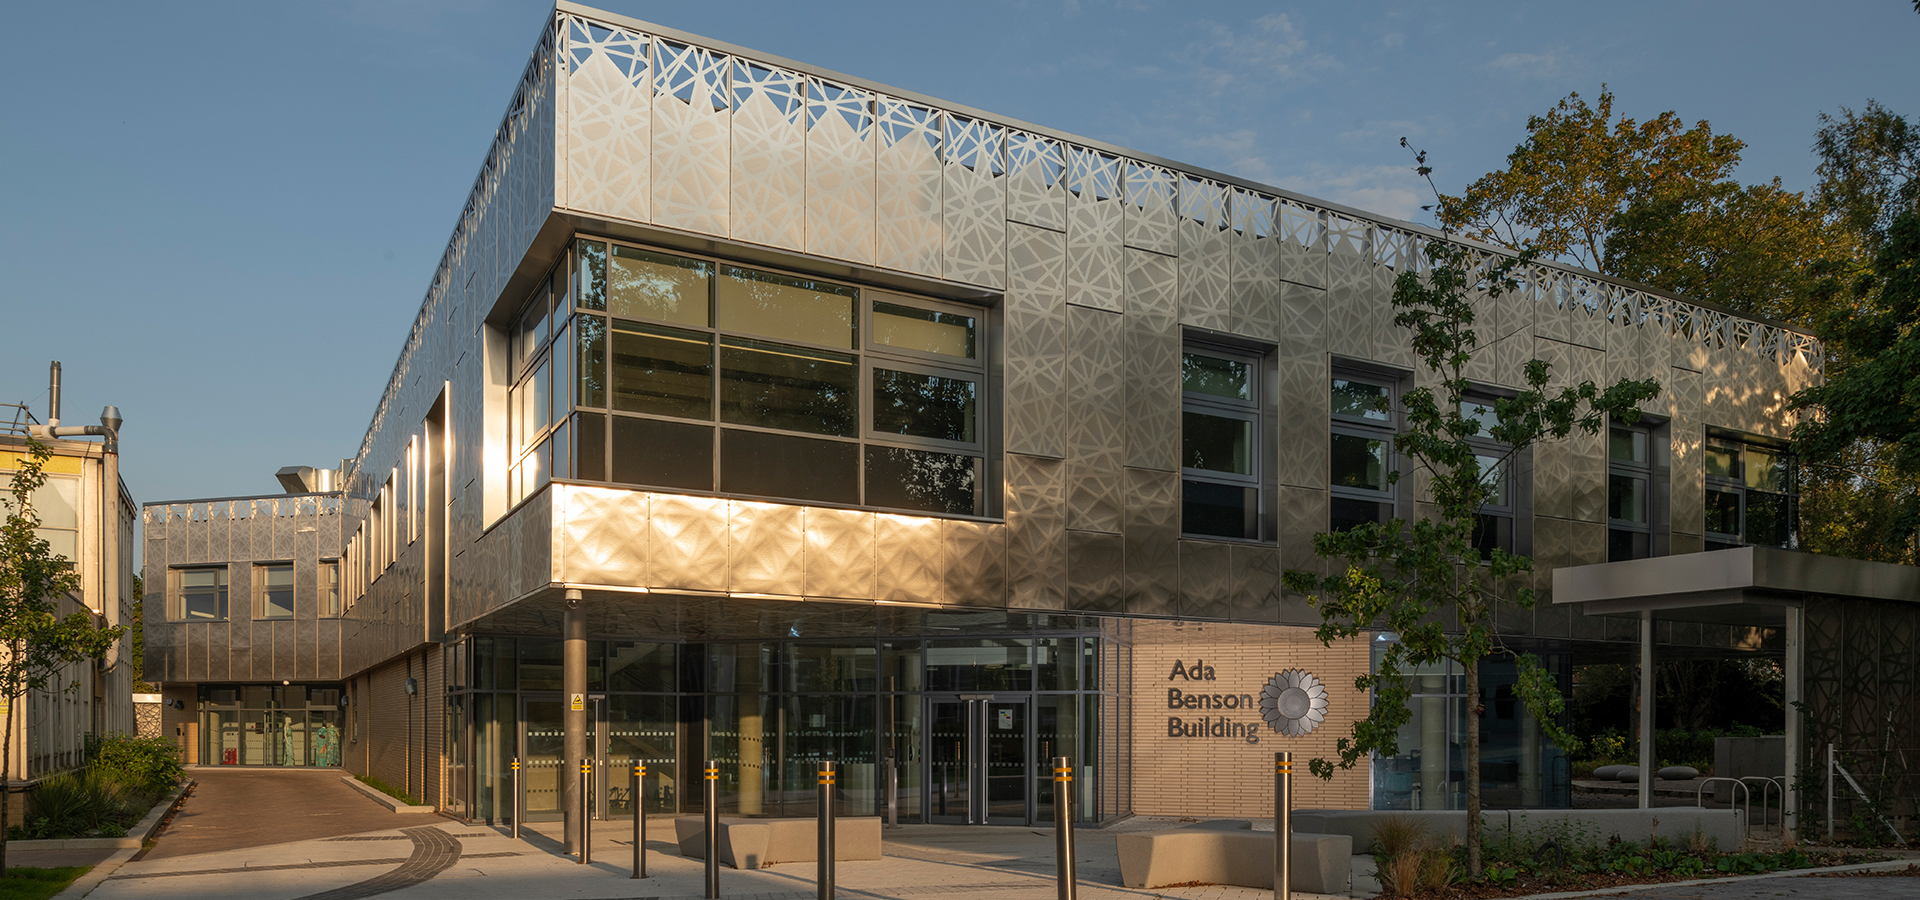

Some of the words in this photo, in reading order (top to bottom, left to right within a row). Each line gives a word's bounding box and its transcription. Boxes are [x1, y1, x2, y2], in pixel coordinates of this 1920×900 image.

[1168, 659, 1216, 681] Ada
[1168, 688, 1253, 709] Benson
[1168, 716, 1260, 744] Building
